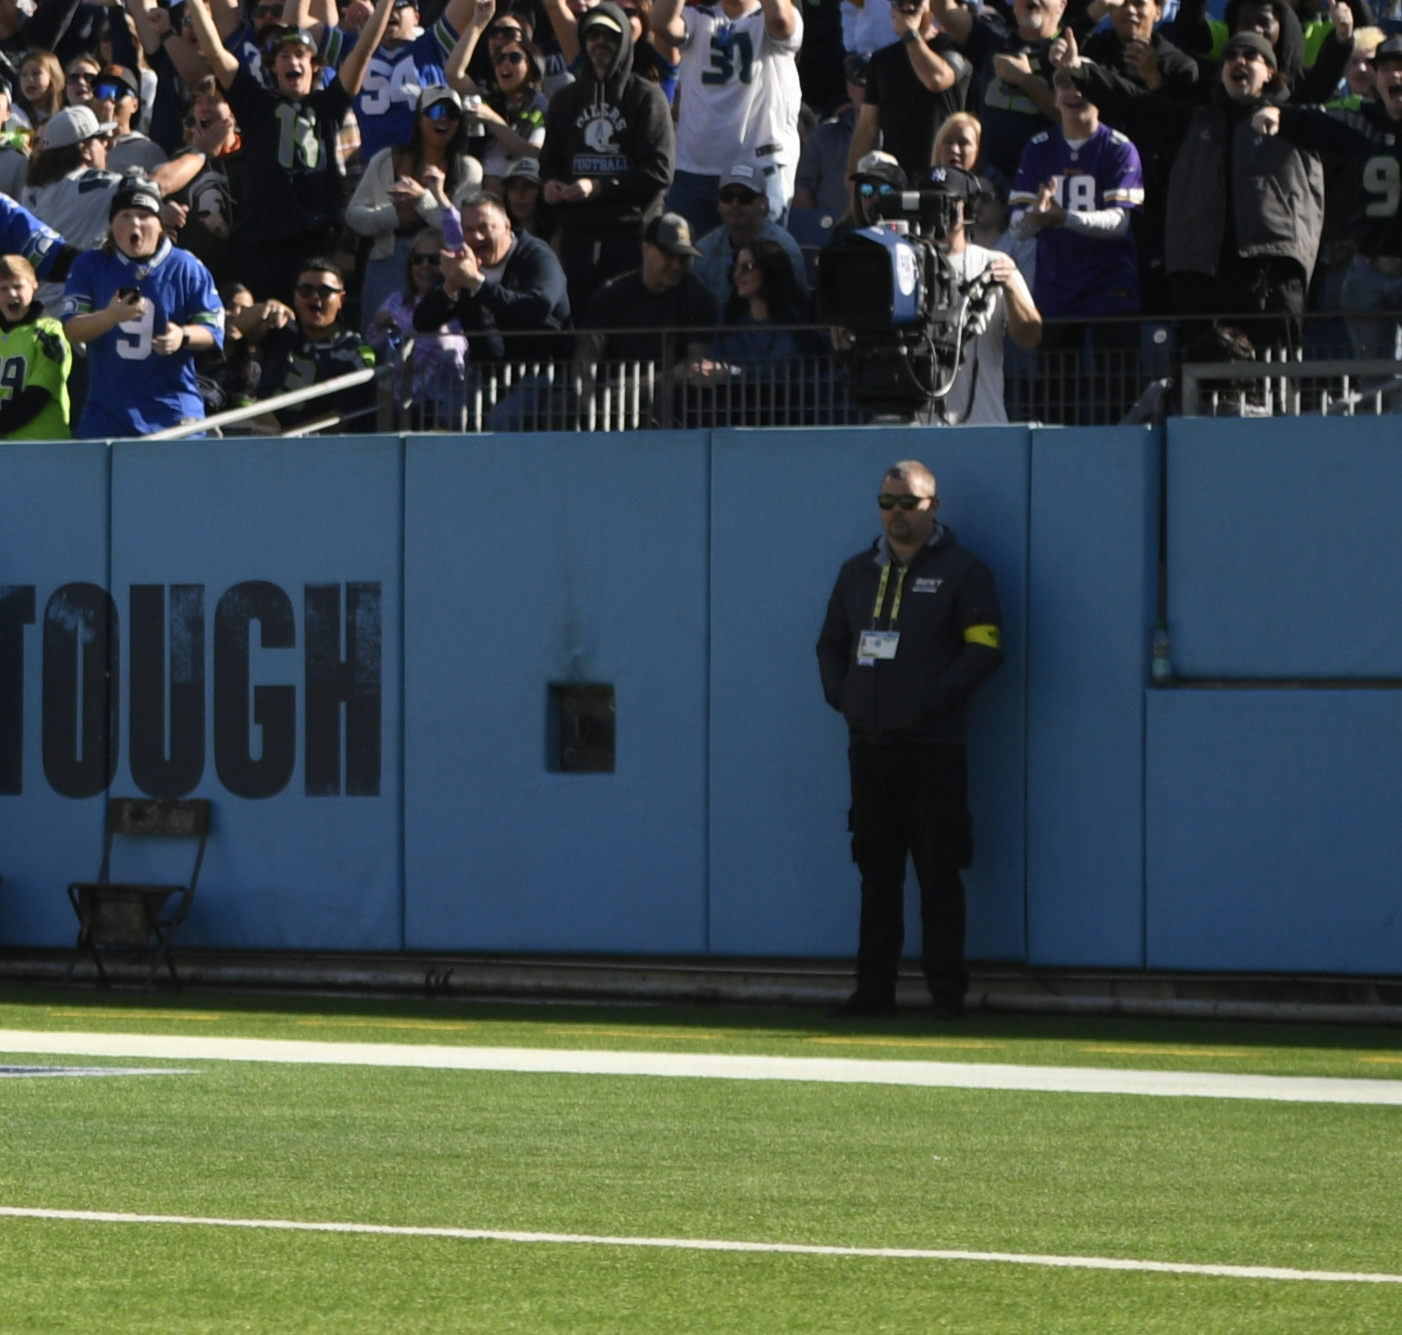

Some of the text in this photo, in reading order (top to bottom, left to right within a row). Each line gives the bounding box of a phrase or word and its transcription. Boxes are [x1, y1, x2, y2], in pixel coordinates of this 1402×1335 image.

[359, 64, 421, 116] 54
[572, 154, 631, 173] FOOTBALL
[1363, 154, 1401, 218] 9
